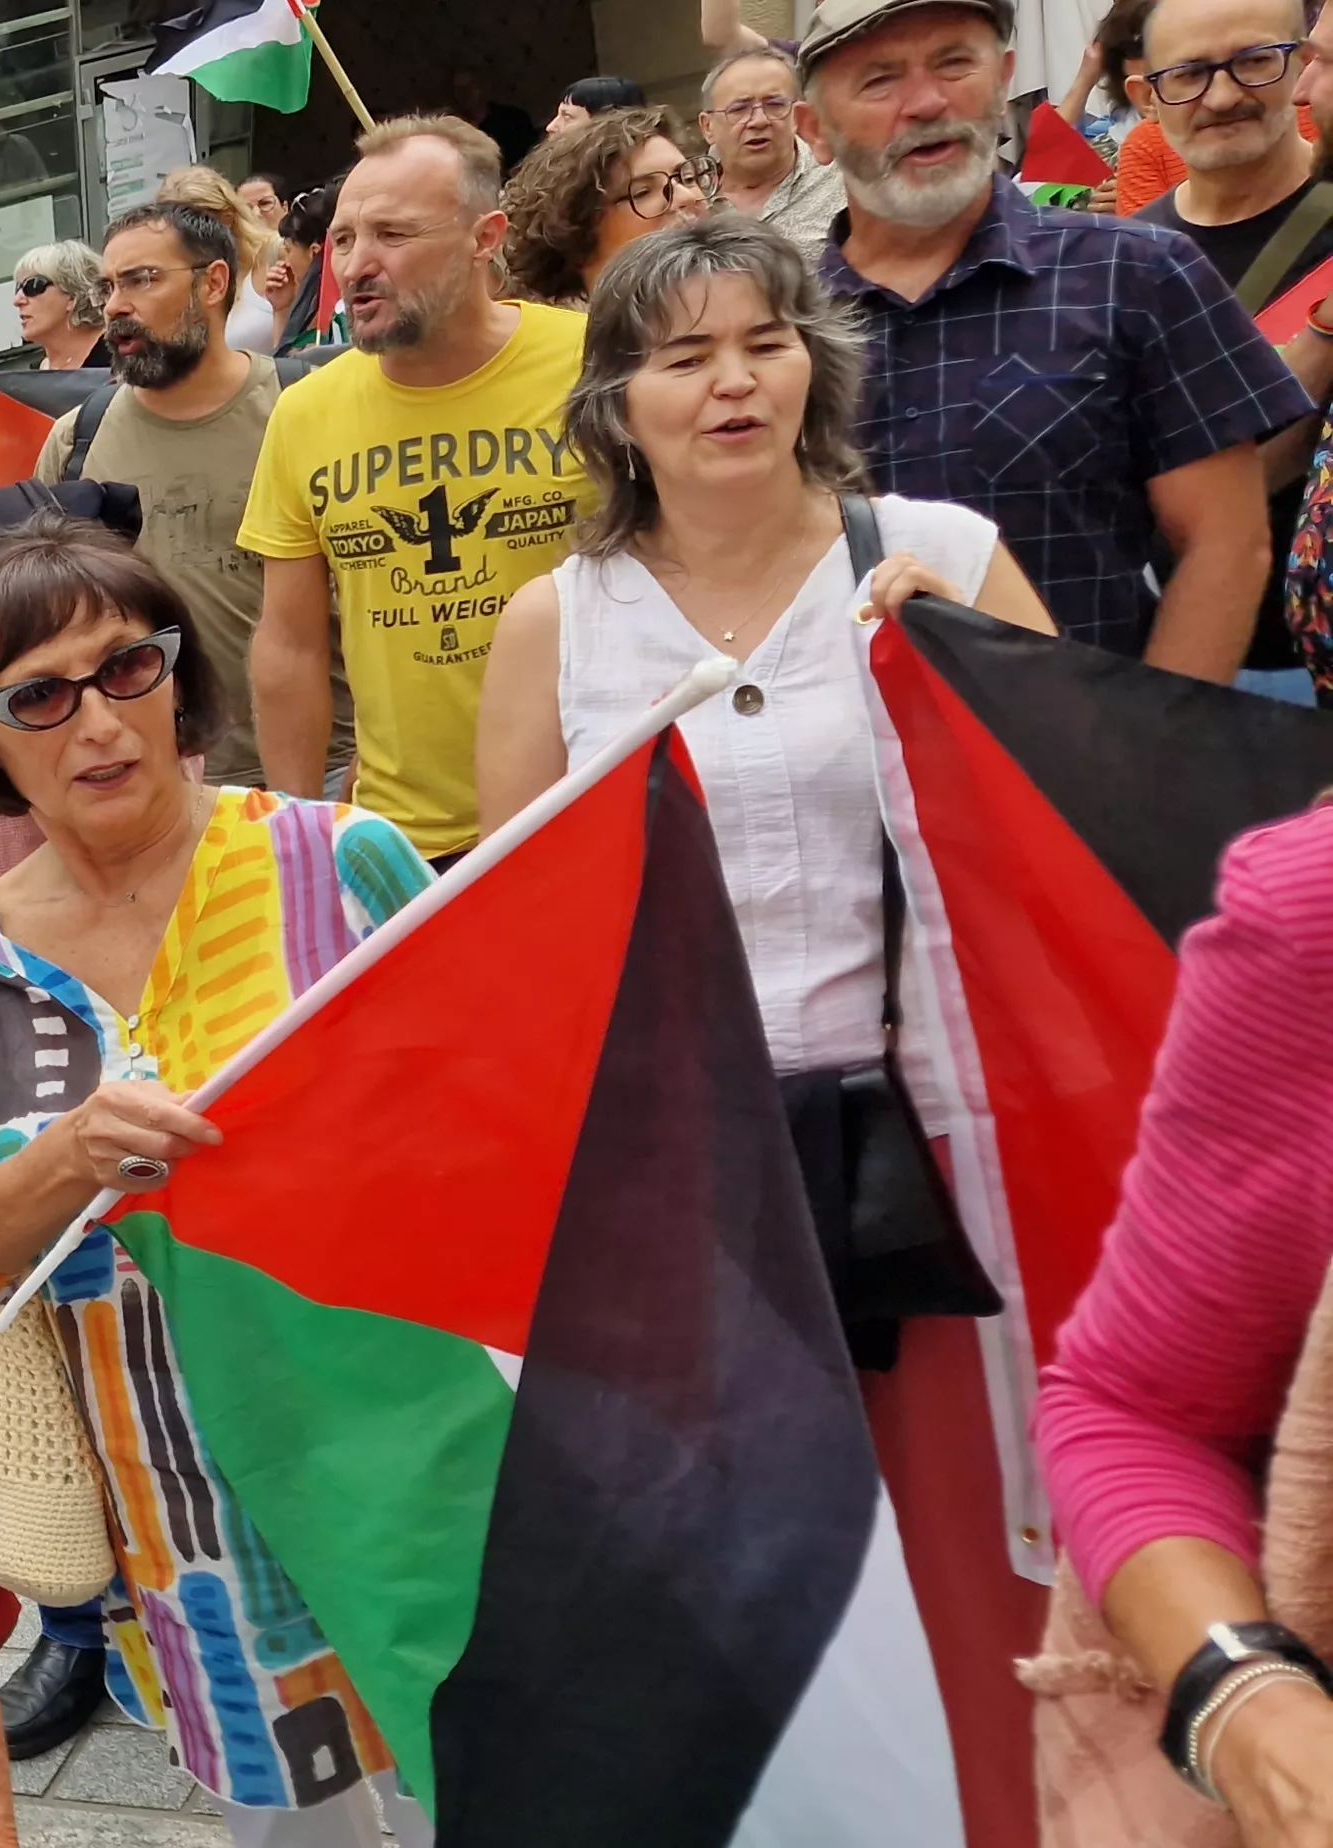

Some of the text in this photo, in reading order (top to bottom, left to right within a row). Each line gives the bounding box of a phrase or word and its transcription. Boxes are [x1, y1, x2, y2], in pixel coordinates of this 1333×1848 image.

[309, 427, 569, 517] SUPERDRY
[502, 490, 564, 509] MFG. CO.
[497, 506, 566, 532] JAPAN
[332, 534, 385, 554] TOKYO
[507, 530, 565, 550] QUALITY
[390, 554, 498, 597] Brand
[431, 593, 515, 624] WEIGH
